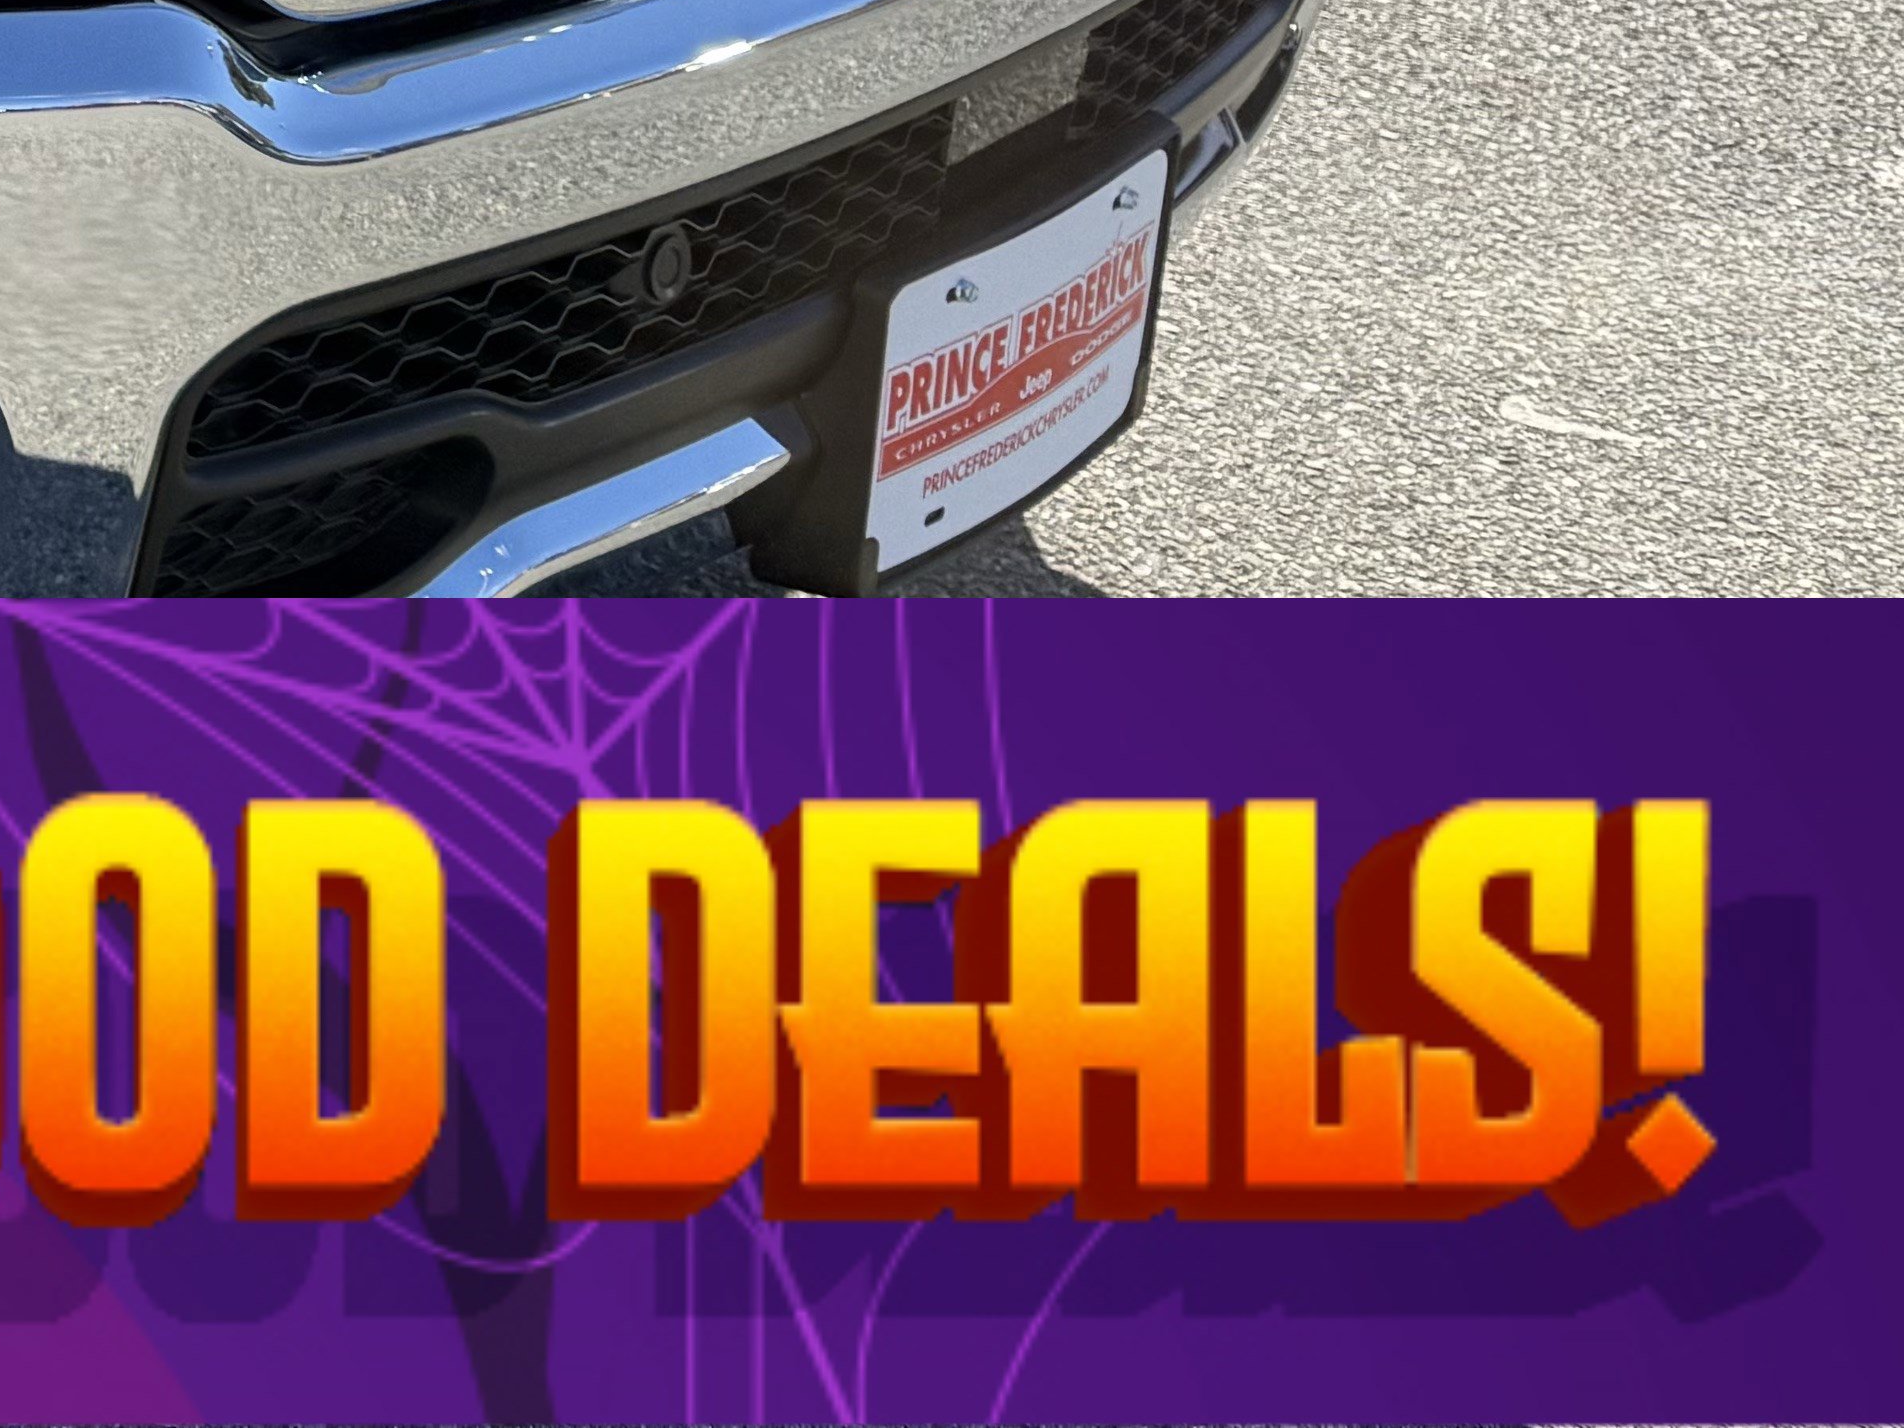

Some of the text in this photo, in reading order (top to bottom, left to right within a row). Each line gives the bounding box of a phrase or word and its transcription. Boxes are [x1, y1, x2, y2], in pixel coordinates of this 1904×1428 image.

[885, 229, 1152, 432] PRINCE FREDERICK
[895, 401, 1001, 461] CHRYSLER
[1019, 367, 1053, 400] Jeep
